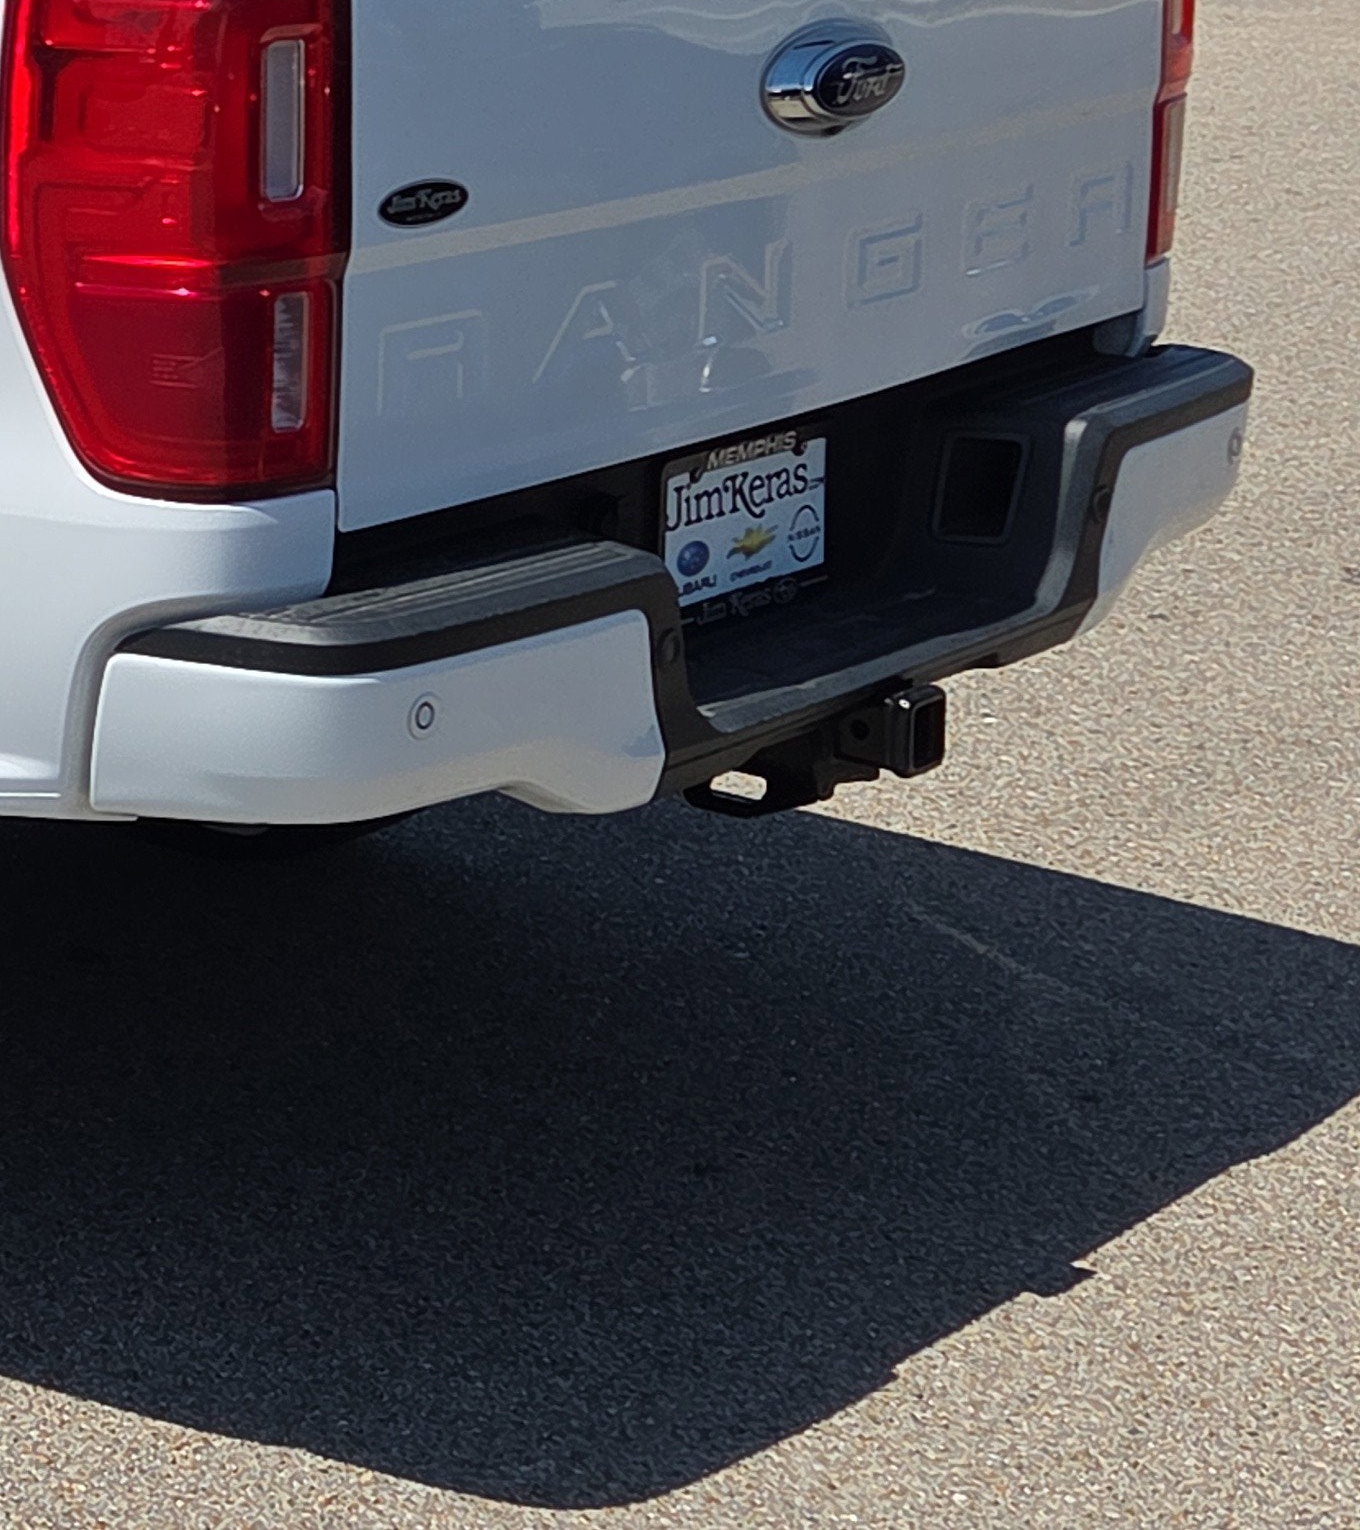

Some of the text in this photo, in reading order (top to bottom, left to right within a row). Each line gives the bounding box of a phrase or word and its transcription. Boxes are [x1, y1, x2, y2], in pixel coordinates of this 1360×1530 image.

[832, 55, 904, 105] Ford
[376, 162, 1135, 418] RANGER
[706, 429, 798, 470] MEMPHIS
